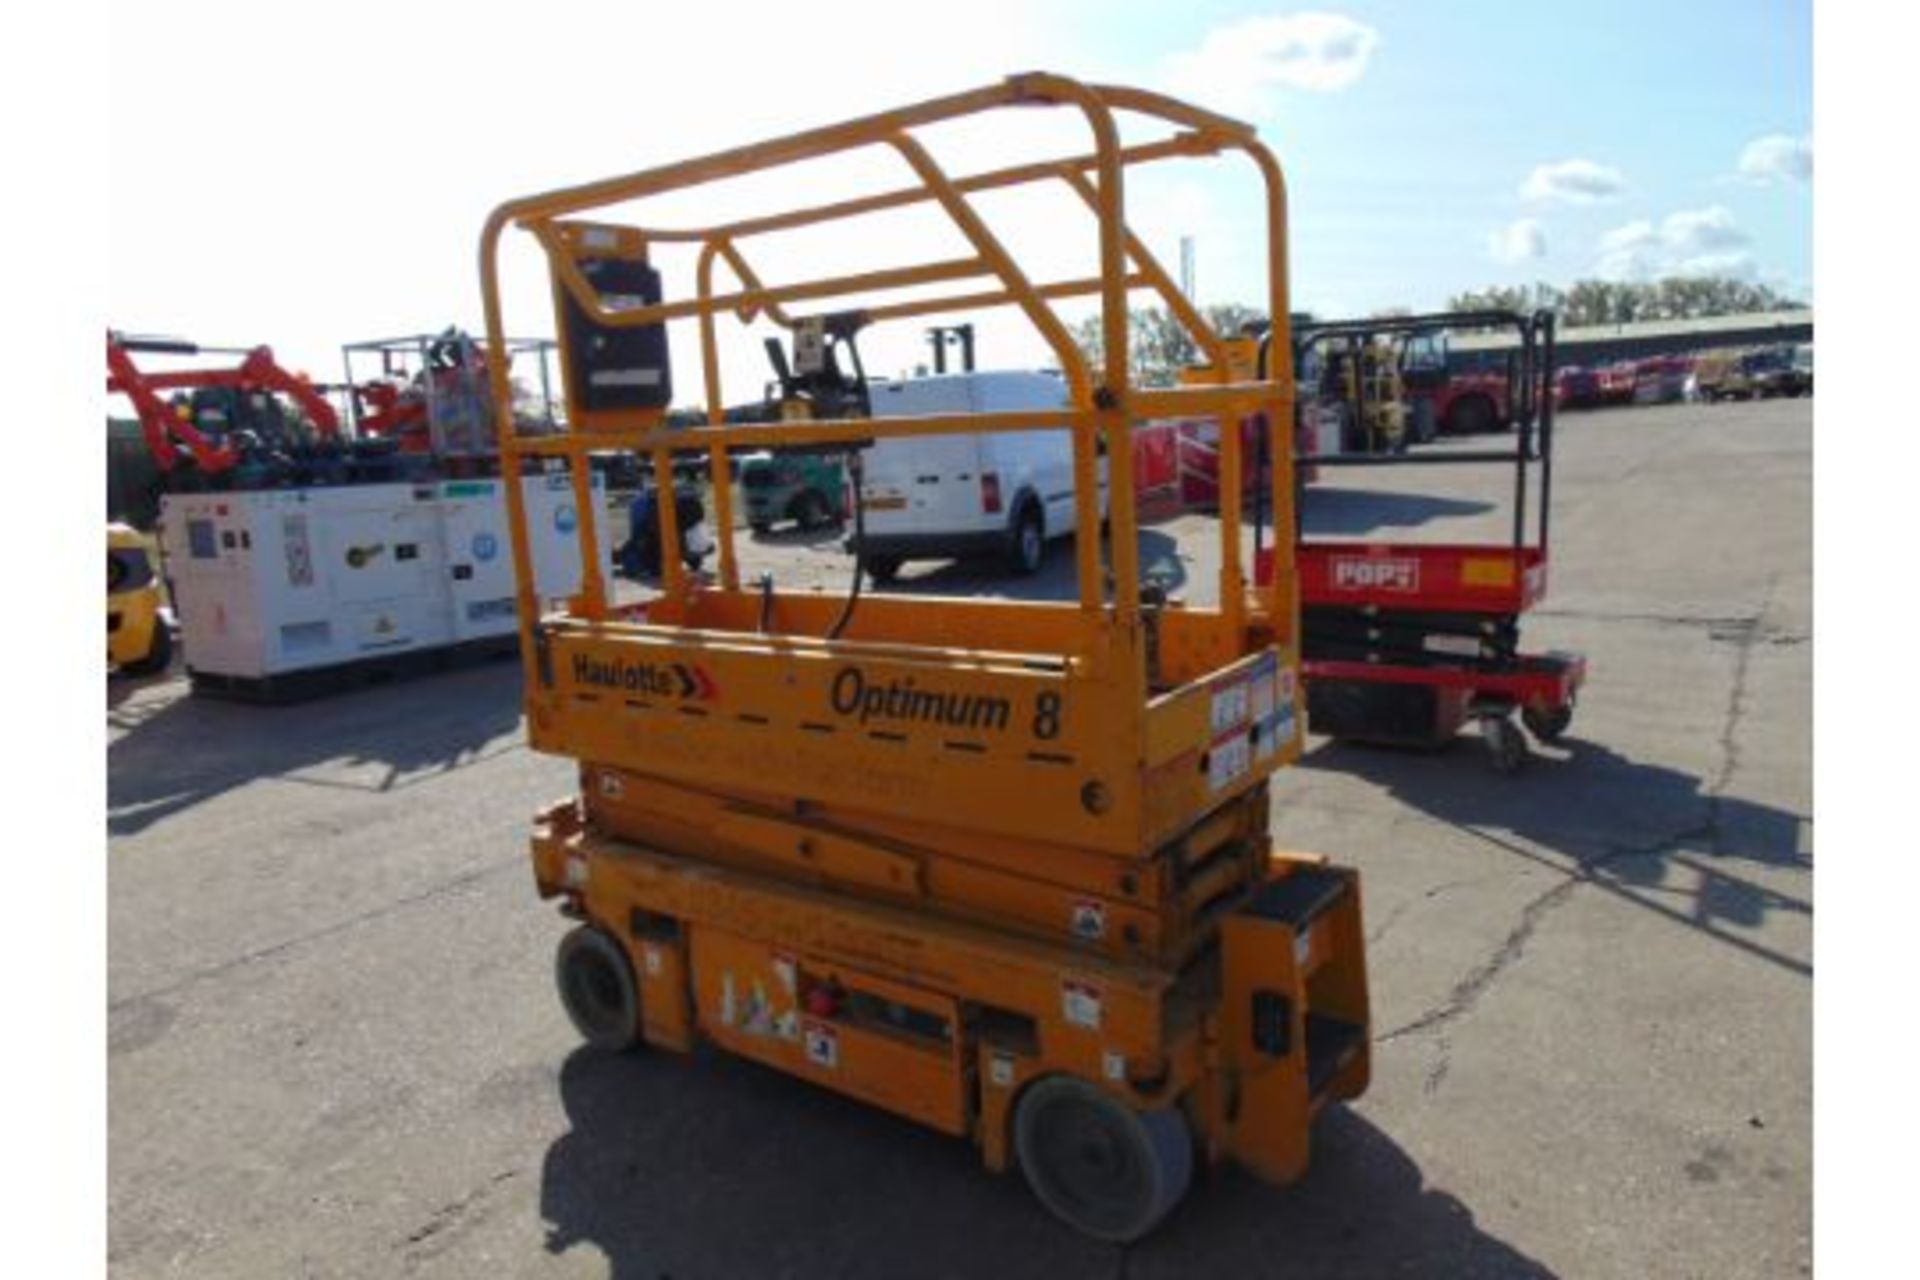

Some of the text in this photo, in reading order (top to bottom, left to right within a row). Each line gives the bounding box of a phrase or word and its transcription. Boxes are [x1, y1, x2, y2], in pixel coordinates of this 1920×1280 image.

[572, 652, 674, 692] Haulotte
[831, 666, 1061, 740] Optimum 8
